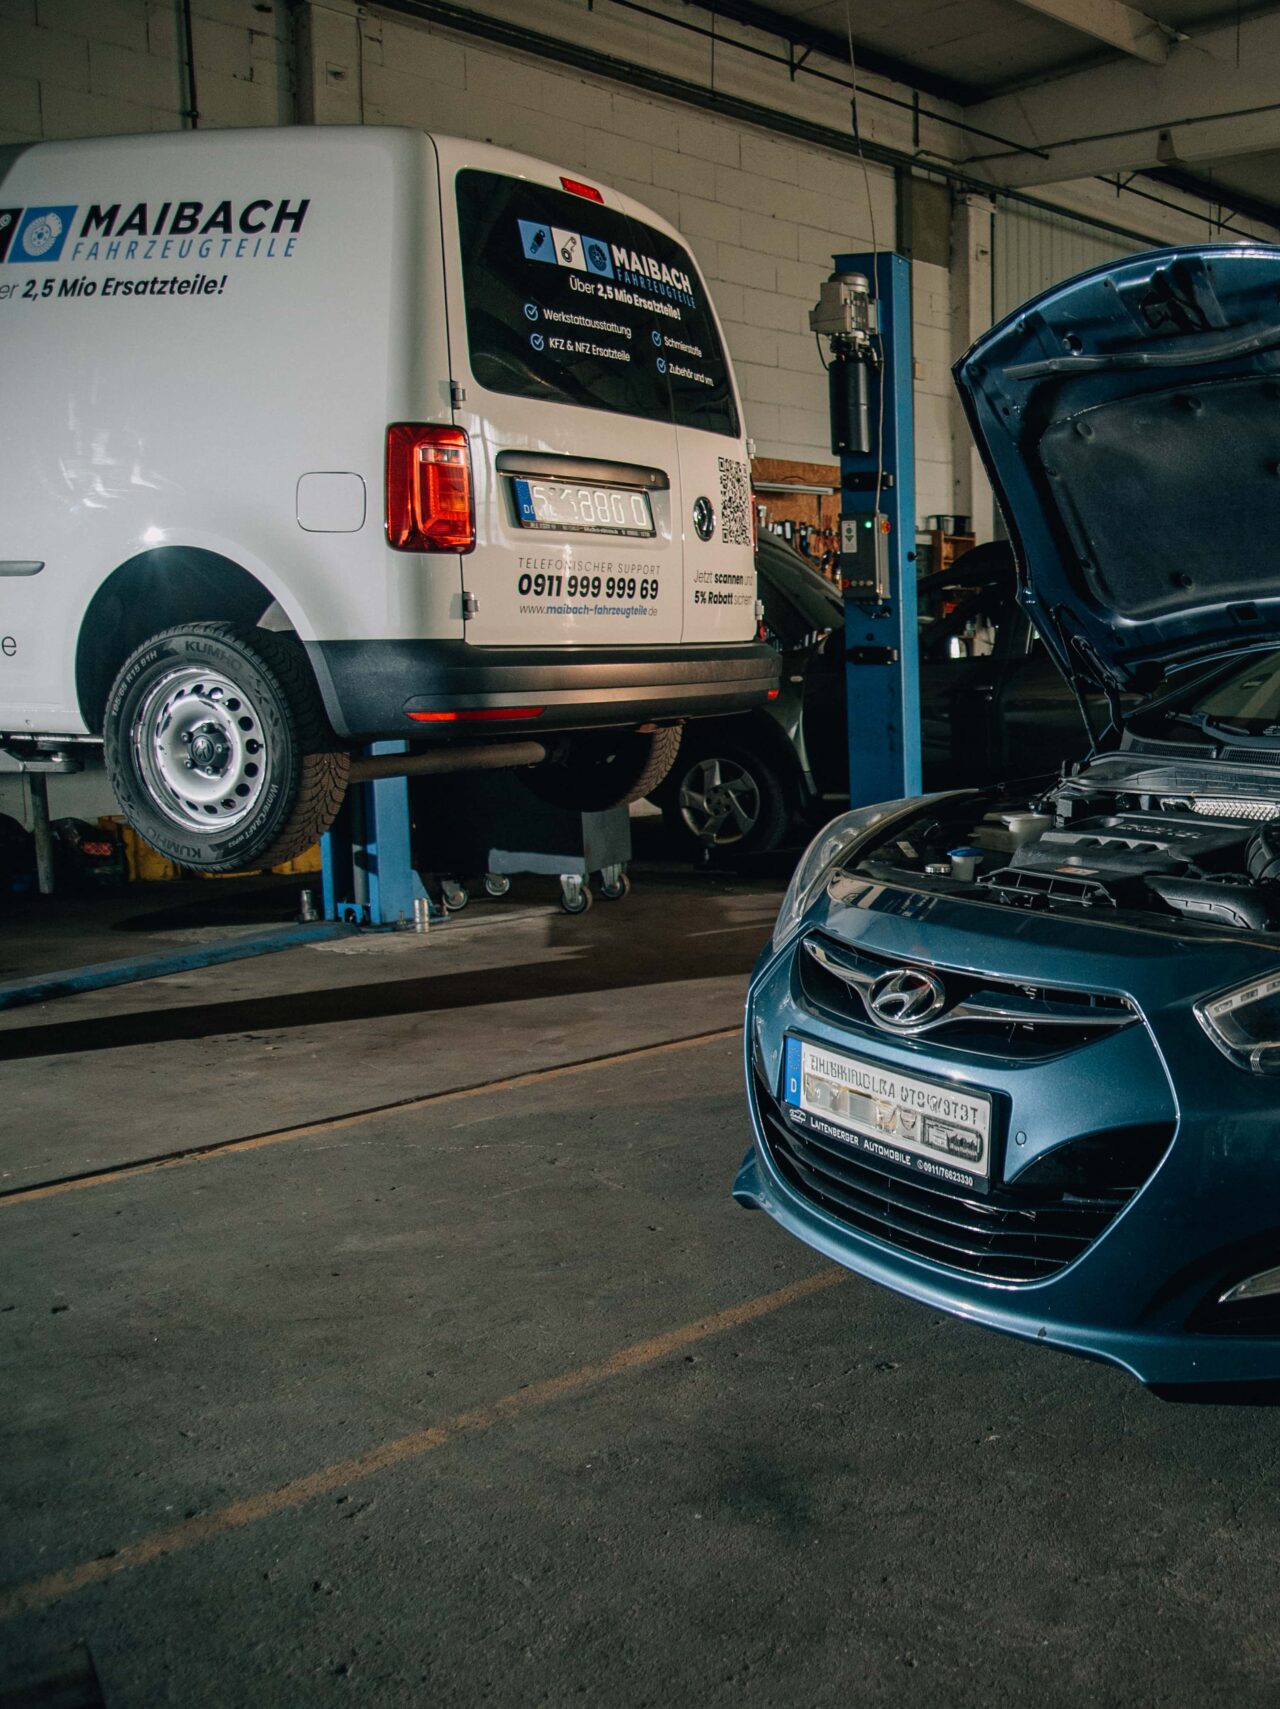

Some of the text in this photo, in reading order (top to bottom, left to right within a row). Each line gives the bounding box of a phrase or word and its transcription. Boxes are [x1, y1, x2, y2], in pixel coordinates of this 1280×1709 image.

[80, 199, 310, 238] MAIBACH
[72, 237, 297, 262] FAHRZEUGTEILE
[611, 244, 692, 295] MAIBACH
[22, 279, 56, 301] 2,5
[58, 277, 97, 297] Mio
[101, 274, 227, 296] Ersatzteile!
[569, 274, 681, 320] Über 2,5 Mio Ersatzteile!
[543, 308, 632, 339] Werkstattausstattung
[549, 338, 631, 362] KFZ & NFZ Ersatzteile
[518, 557, 661, 576] TELEFONISCHER SUPPORT
[714, 573, 744, 585] scannen
[518, 573, 659, 600] 0911 999 999 69
[694, 590, 707, 604] 5%
[707, 591, 733, 605] Rabatt
[185, 640, 242, 671] KUMHO
[145, 825, 202, 859] KUMHO
[790, 1077, 798, 1093] D
[863, 1139, 912, 1167] AUTOMOBILE
